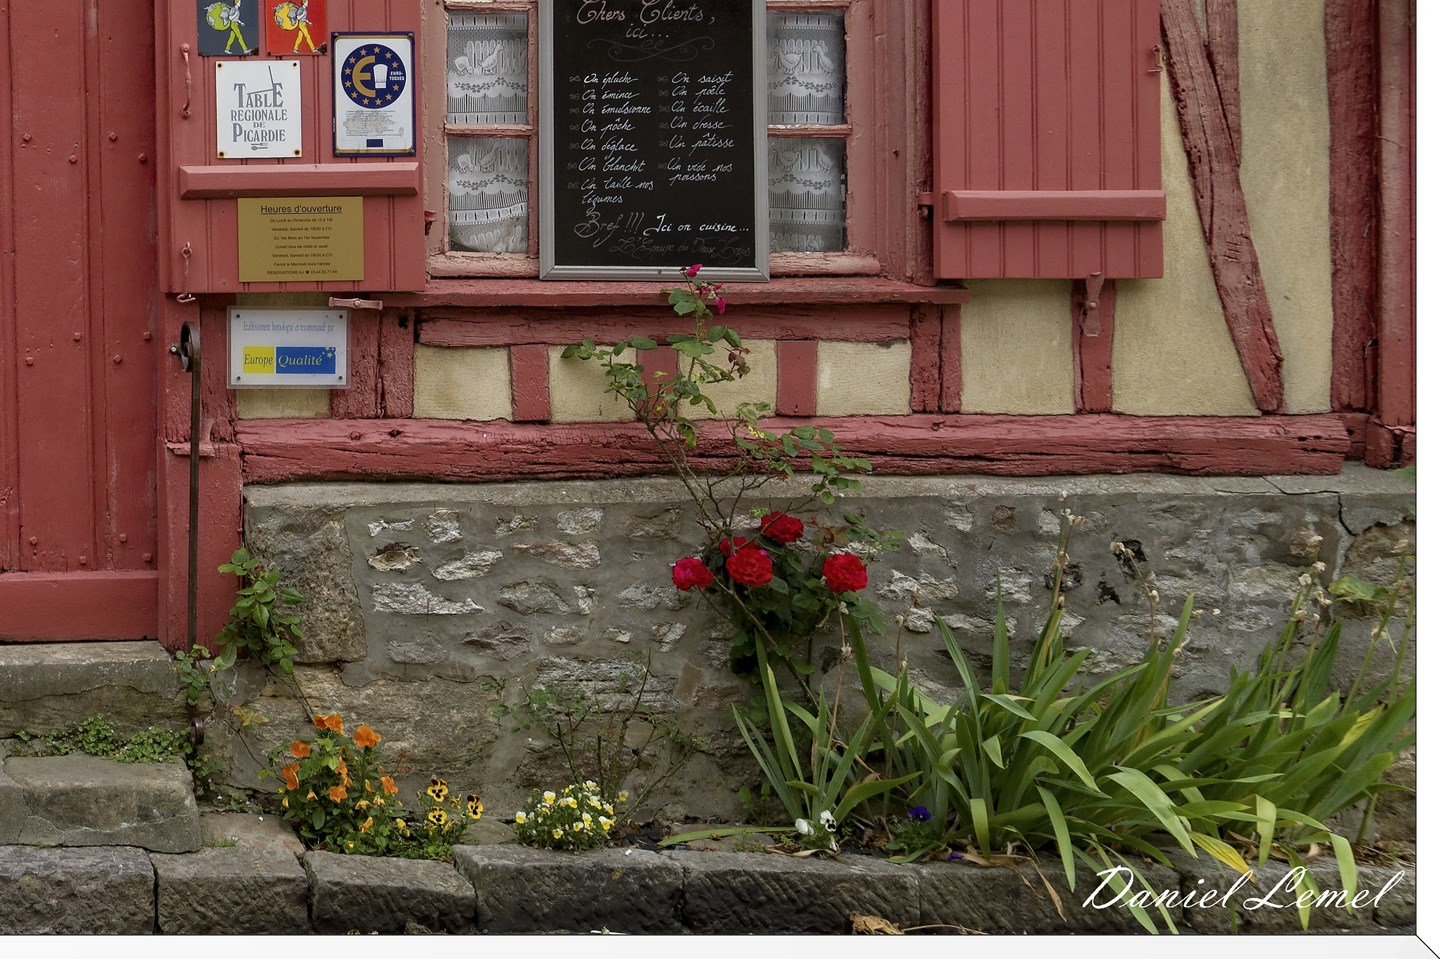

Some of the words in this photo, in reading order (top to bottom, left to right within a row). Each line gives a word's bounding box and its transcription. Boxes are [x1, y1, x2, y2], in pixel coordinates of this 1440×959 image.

[583, 72, 599, 84] On
[601, 71, 638, 89] épluche
[671, 71, 690, 84] On
[233, 82, 284, 108] TABLE
[581, 89, 596, 101] On
[671, 85, 688, 97] On
[582, 102, 595, 115] On
[671, 100, 686, 113] On
[230, 109, 288, 121] REGIONALE
[670, 115, 688, 129] On
[232, 122, 286, 142] PICARDIE
[581, 118, 597, 133] On
[580, 138, 596, 151] On
[669, 134, 686, 149] On
[578, 156, 597, 171] On
[667, 157, 682, 171] On
[712, 163, 733, 172] nos
[580, 177, 598, 191] On
[603, 176, 634, 190] taille
[635, 180, 654, 191] nos
[260, 204, 292, 213] Heures
[294, 204, 342, 213] d'ouverture
[574, 211, 624, 248] Bref
[643, 213, 672, 236] Ici
[677, 224, 692, 232] on
[244, 353, 273, 367] Europe
[278, 353, 323, 368] Qualité
